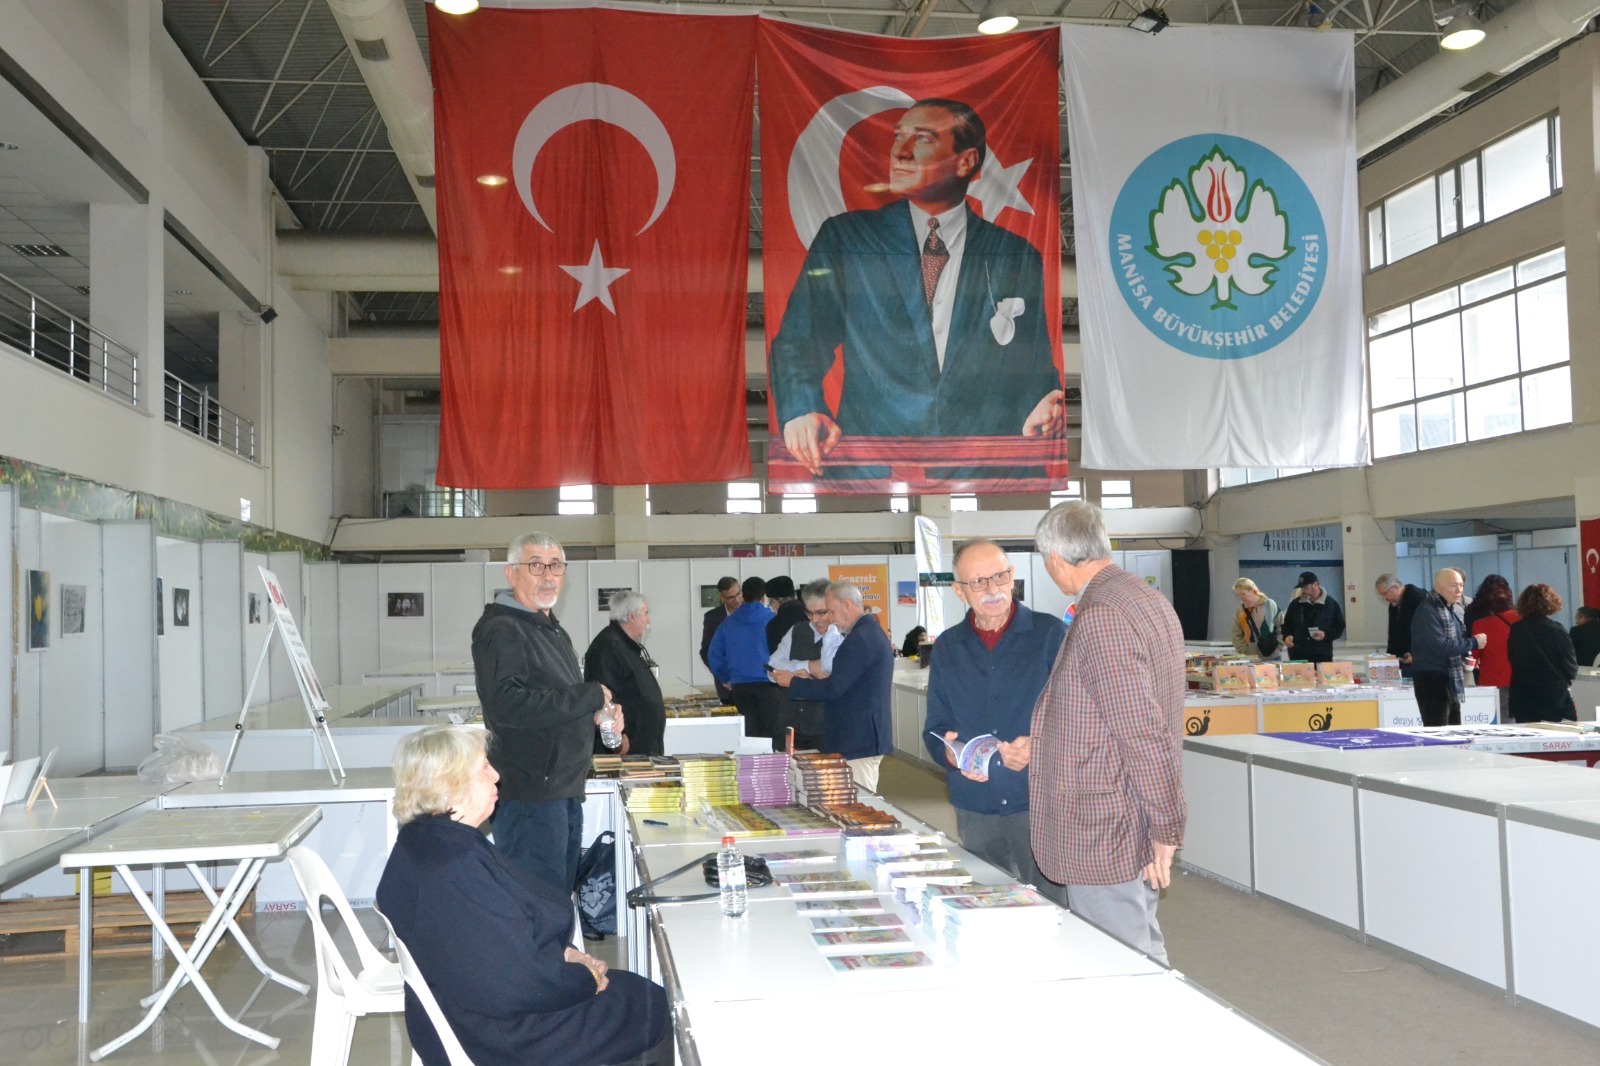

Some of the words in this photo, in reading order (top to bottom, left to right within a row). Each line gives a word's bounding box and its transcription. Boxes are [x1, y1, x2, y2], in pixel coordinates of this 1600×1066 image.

[1117, 233, 1153, 310] MANİSA
[1152, 306, 1269, 350] BÜYÜKŞEHİR
[1268, 233, 1319, 331] BELEDİYESİ
[1272, 539, 1298, 552] FARKLI
[1302, 539, 1334, 552] KONSEPT
[1392, 716, 1414, 726] Kitap
[1542, 742, 1572, 750] SARAY
[264, 902, 296, 911] SARAY
